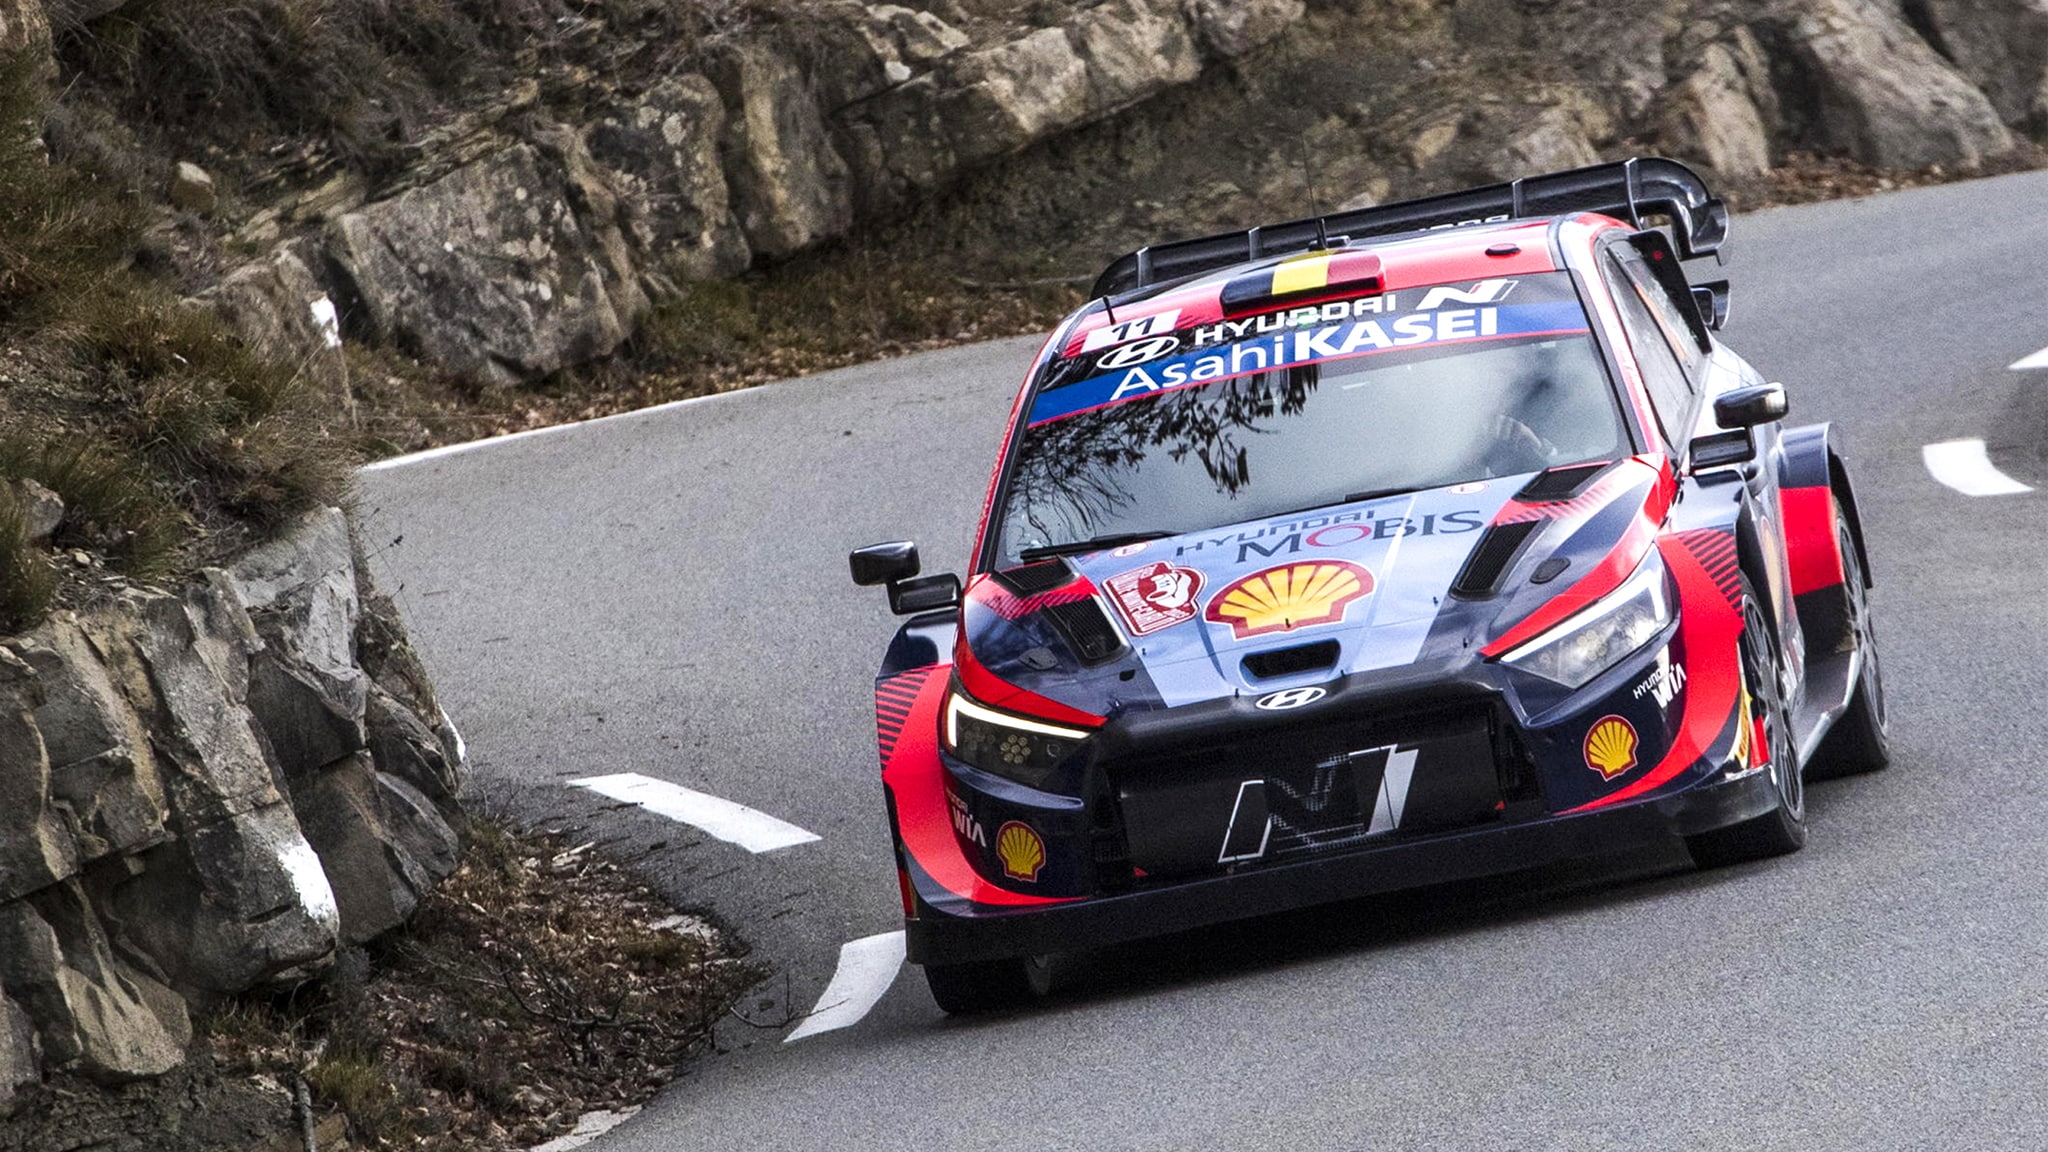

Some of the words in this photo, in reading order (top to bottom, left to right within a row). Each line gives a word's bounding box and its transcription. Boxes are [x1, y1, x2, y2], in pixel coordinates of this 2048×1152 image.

[1112, 316, 1156, 341] 11
[1194, 294, 1397, 346] HYUNDAI
[1175, 510, 1375, 557] HYUNDAI
[1235, 510, 1485, 563] MOBIS
